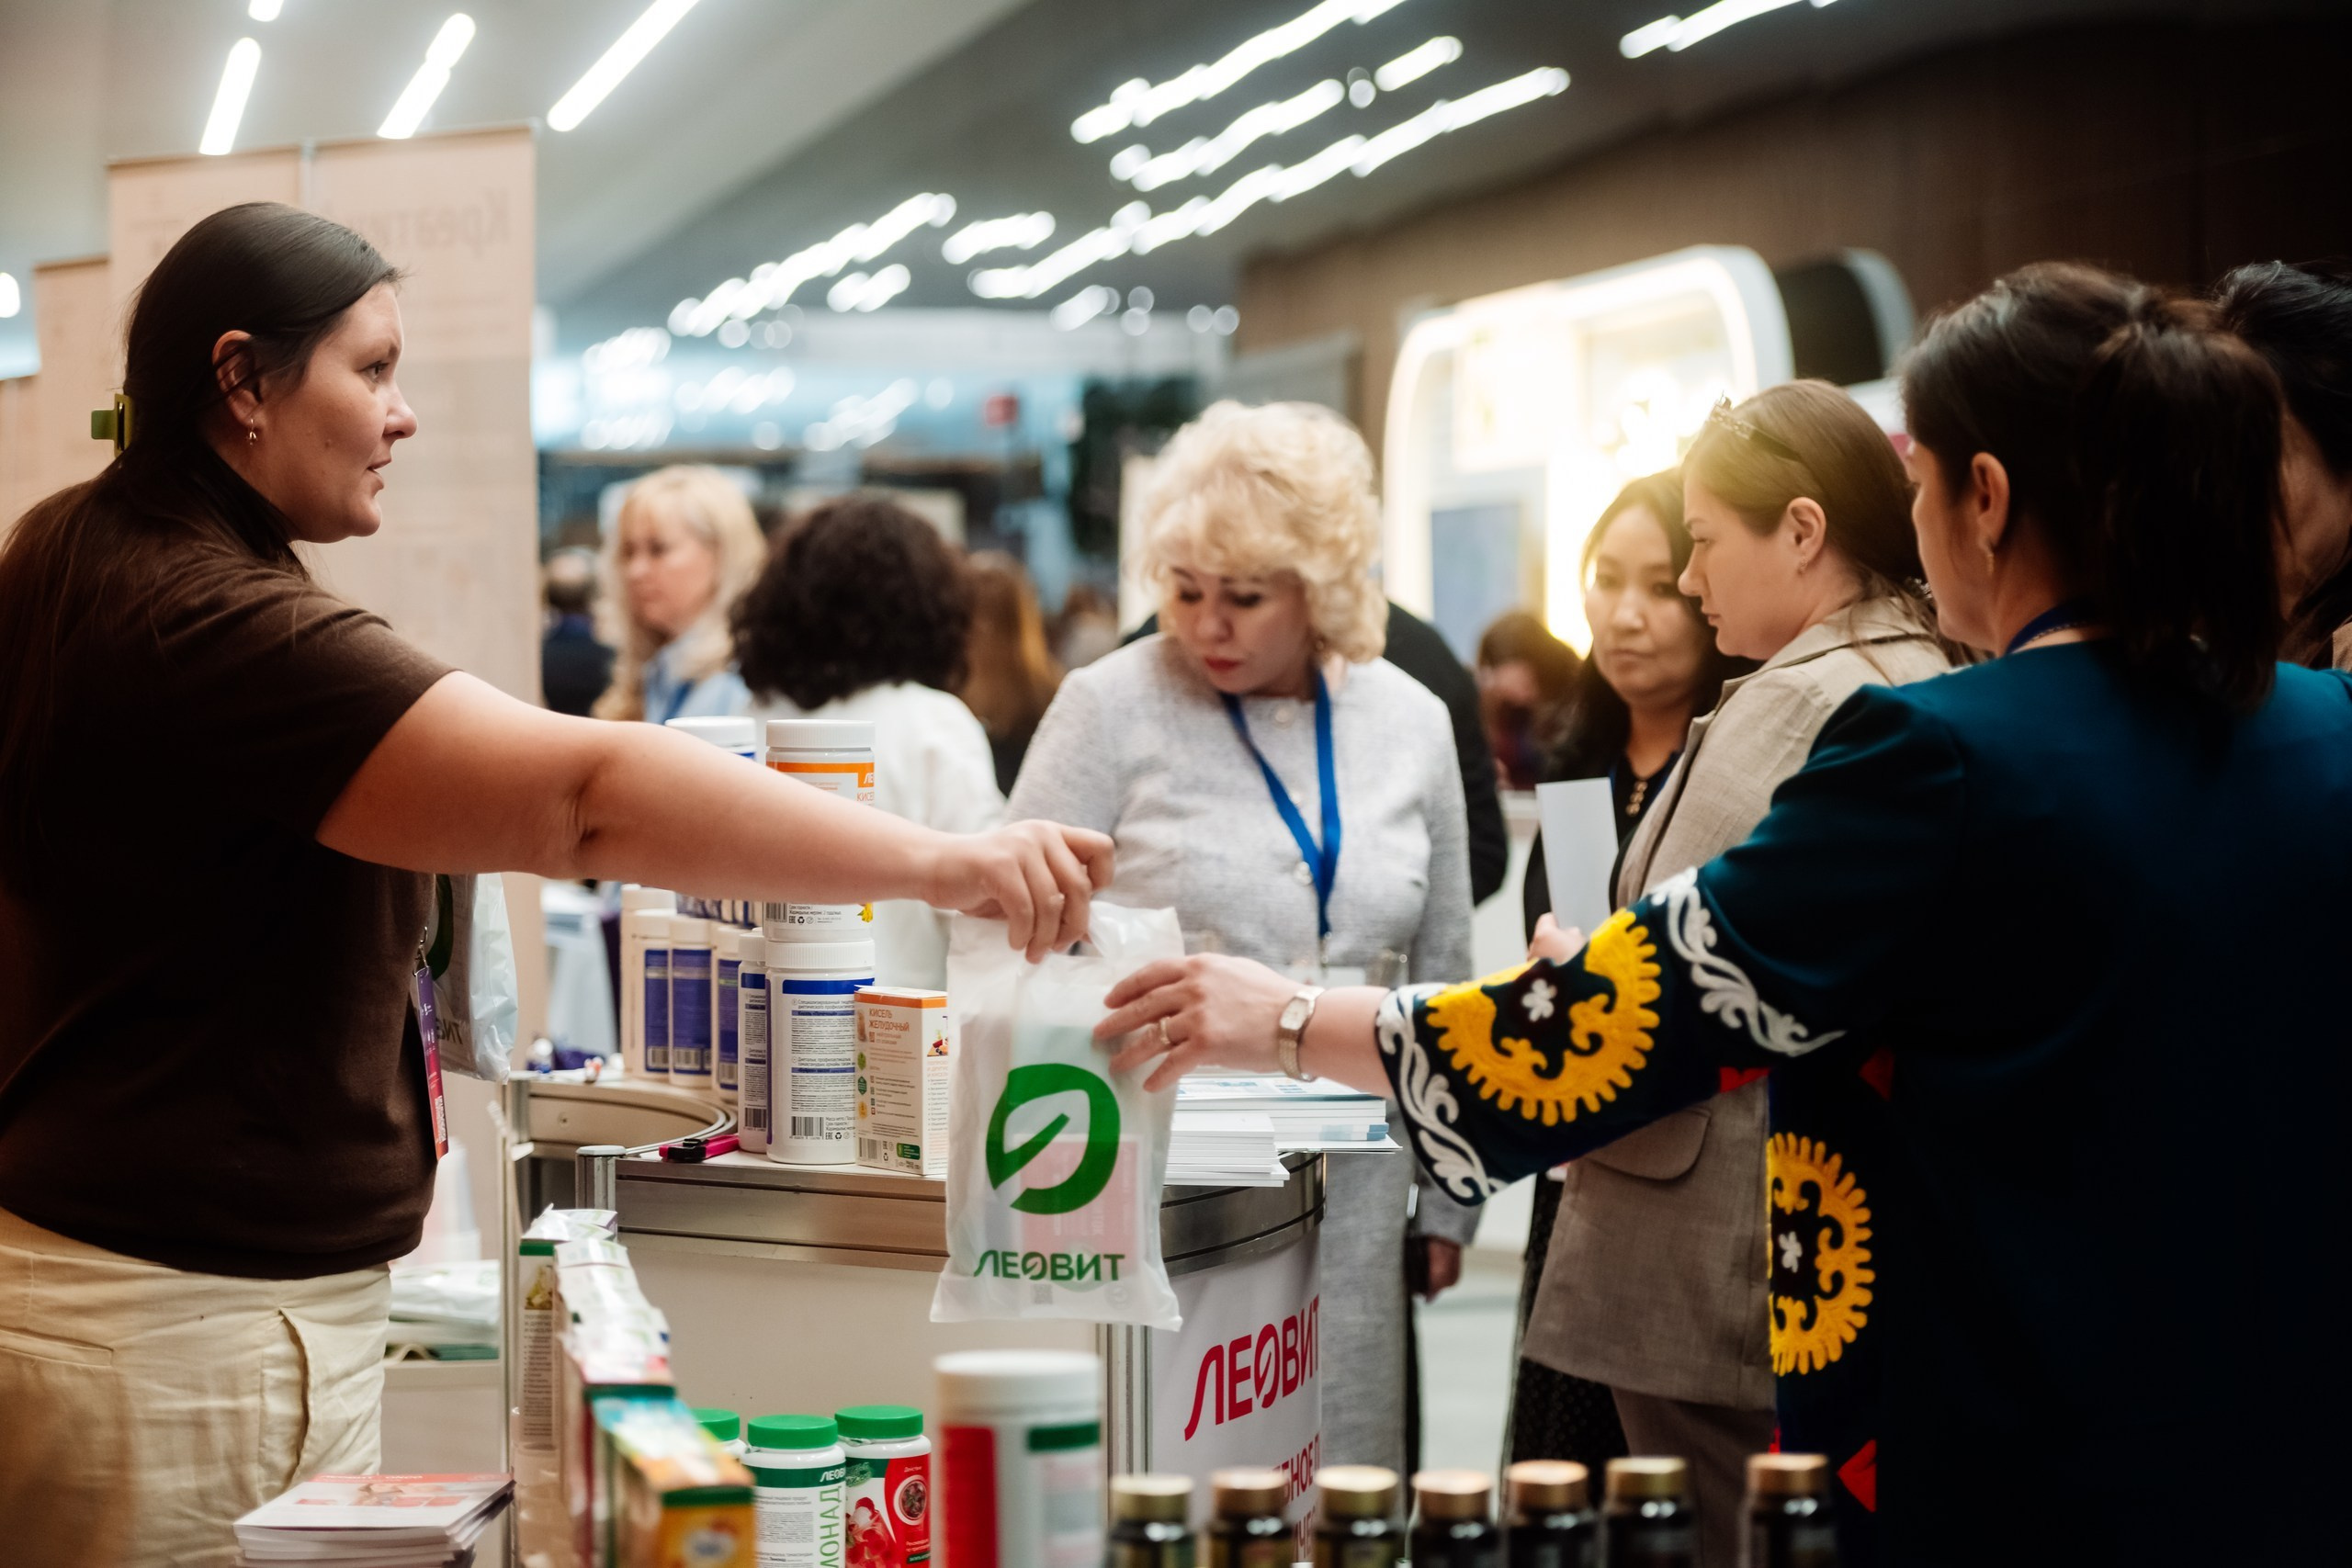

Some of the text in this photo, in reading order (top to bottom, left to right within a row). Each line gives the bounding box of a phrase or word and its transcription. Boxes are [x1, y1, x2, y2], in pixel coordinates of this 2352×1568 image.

[869, 1008, 892, 1019] КИСЕЛЬ
[869, 1020, 910, 1032] ЖЕЛУДОЧНЫЙ
[974, 1249, 1125, 1281] ЛЕОВИТ
[1184, 1293, 1319, 1441] ЛЕОВИТ
[1272, 1441, 1313, 1506] БНОЕ
